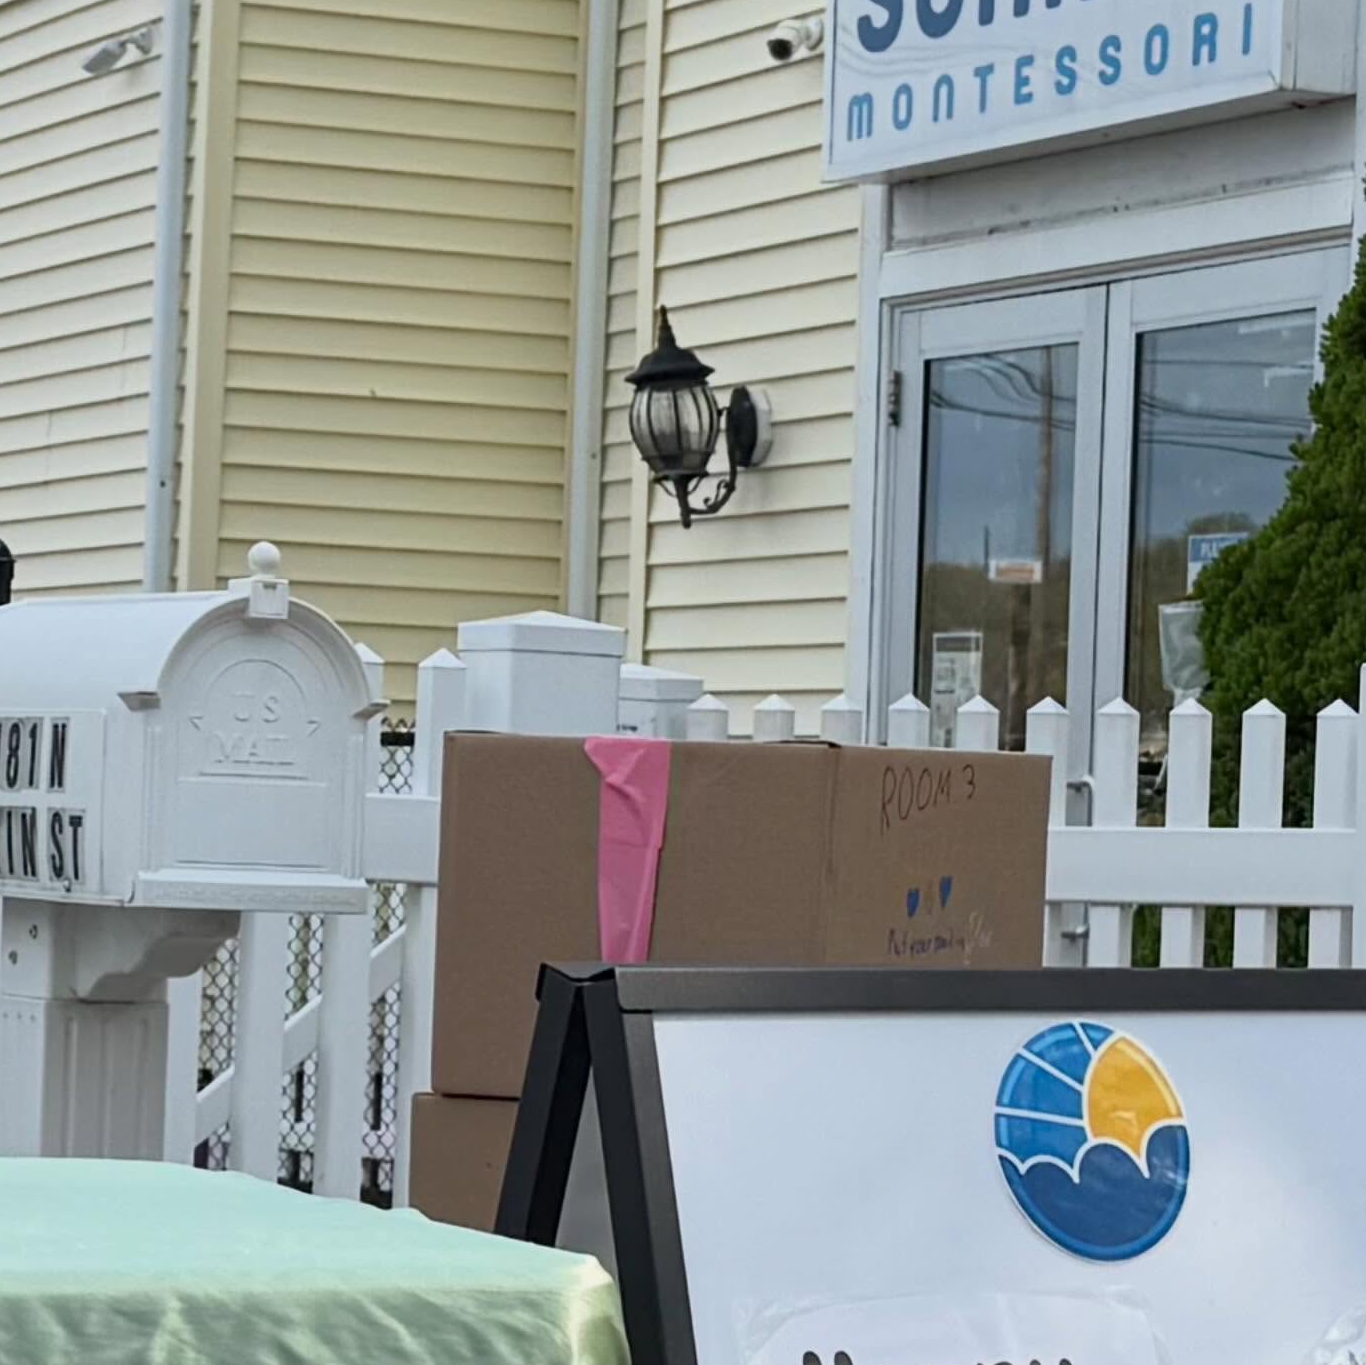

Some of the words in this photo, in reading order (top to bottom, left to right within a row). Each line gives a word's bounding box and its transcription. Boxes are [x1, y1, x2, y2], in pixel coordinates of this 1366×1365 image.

[846, 3, 1253, 141] MONTESSORI
[50, 723, 67, 788] N
[881, 765, 952, 834] ROOM
[962, 764, 977, 800] 3
[51, 811, 84, 881] ST
